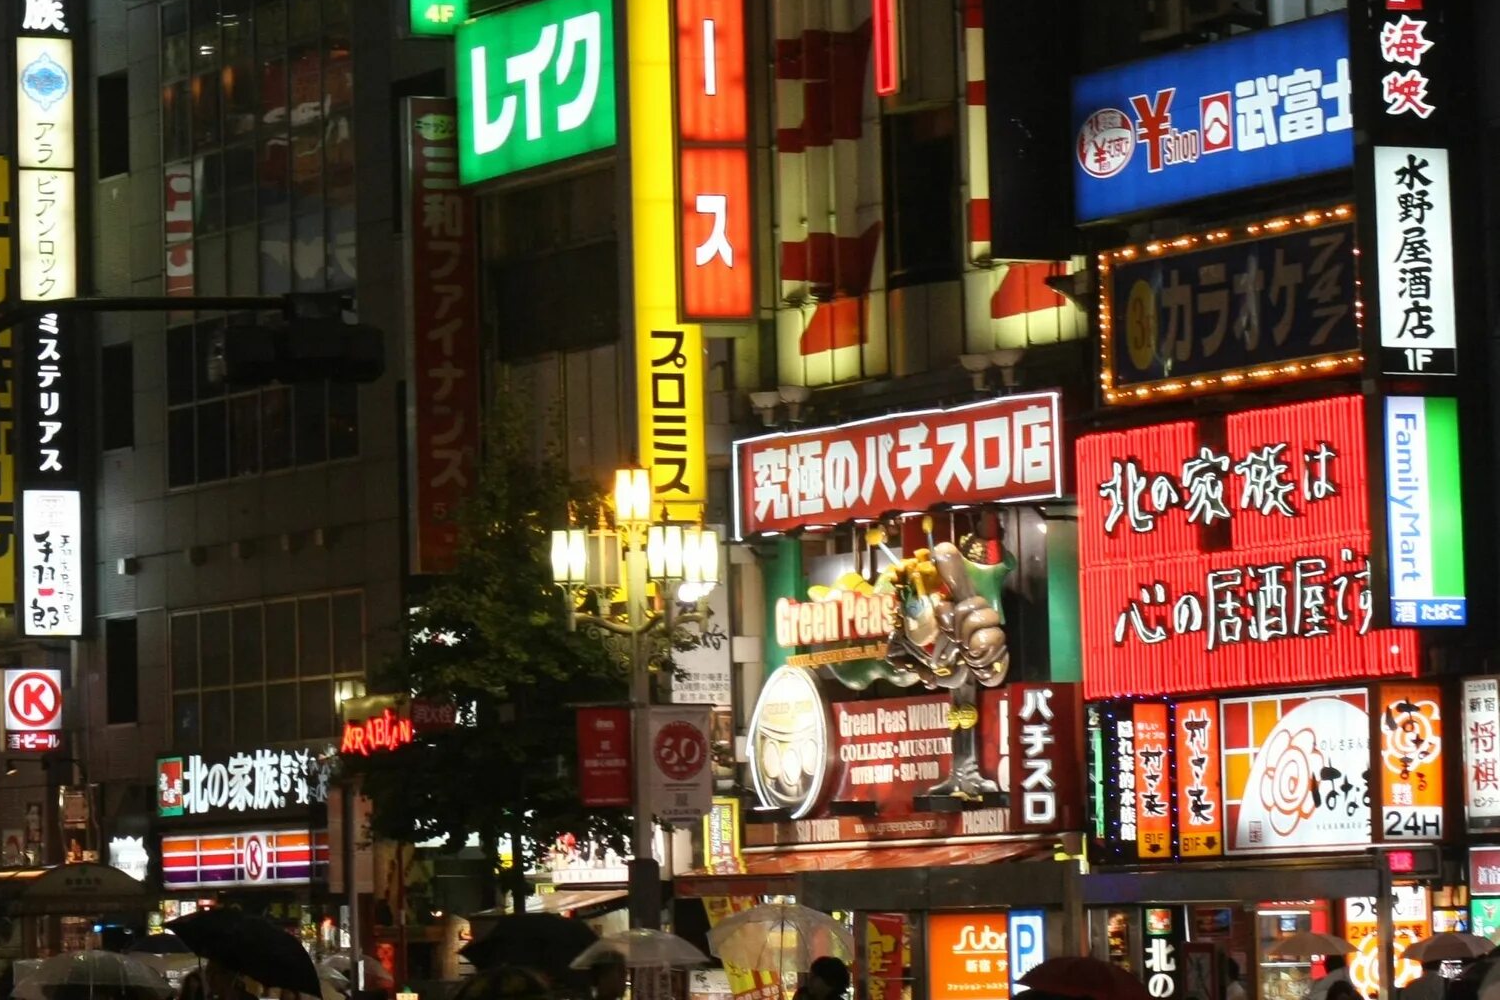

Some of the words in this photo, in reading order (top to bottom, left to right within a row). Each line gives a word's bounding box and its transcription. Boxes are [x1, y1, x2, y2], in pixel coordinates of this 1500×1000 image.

[424, 5, 456, 23] 4F
[469, 11, 602, 156] レイク
[1234, 57, 1354, 153] 武富士
[35, 122, 58, 298] アラビアンロック
[1394, 154, 1437, 341] 水野屋酒店
[421, 146, 468, 490] 三和ファイナンス
[1160, 258, 1303, 363] カラオケ
[1308, 232, 1346, 346] 747
[37, 313, 62, 473] ミステリアス
[1403, 349, 1434, 372] 1F
[650, 330, 691, 496] プロミス
[751, 405, 1053, 521] 究極のパチスロ店
[1100, 441, 1338, 534] 北の家族は
[1389, 412, 1422, 582] FamilyMart
[776, 596, 839, 648] Green
[842, 591, 896, 638] Peas
[1113, 546, 1374, 652] 心の居酒屋です
[1420, 602, 1463, 621] たばこ
[839, 709, 876, 737] Green
[877, 706, 907, 735] Peas
[1469, 697, 1496, 713] 新宿
[183, 750, 280, 814] 北の家族
[1018, 688, 1057, 827] パチスロ
[1115, 720, 1137, 842] 隠れ家的水族館
[1469, 720, 1499, 792] 将棋
[1384, 811, 1441, 837] 24H
[1017, 924, 1035, 973] P
[1144, 938, 1177, 998] 北の
